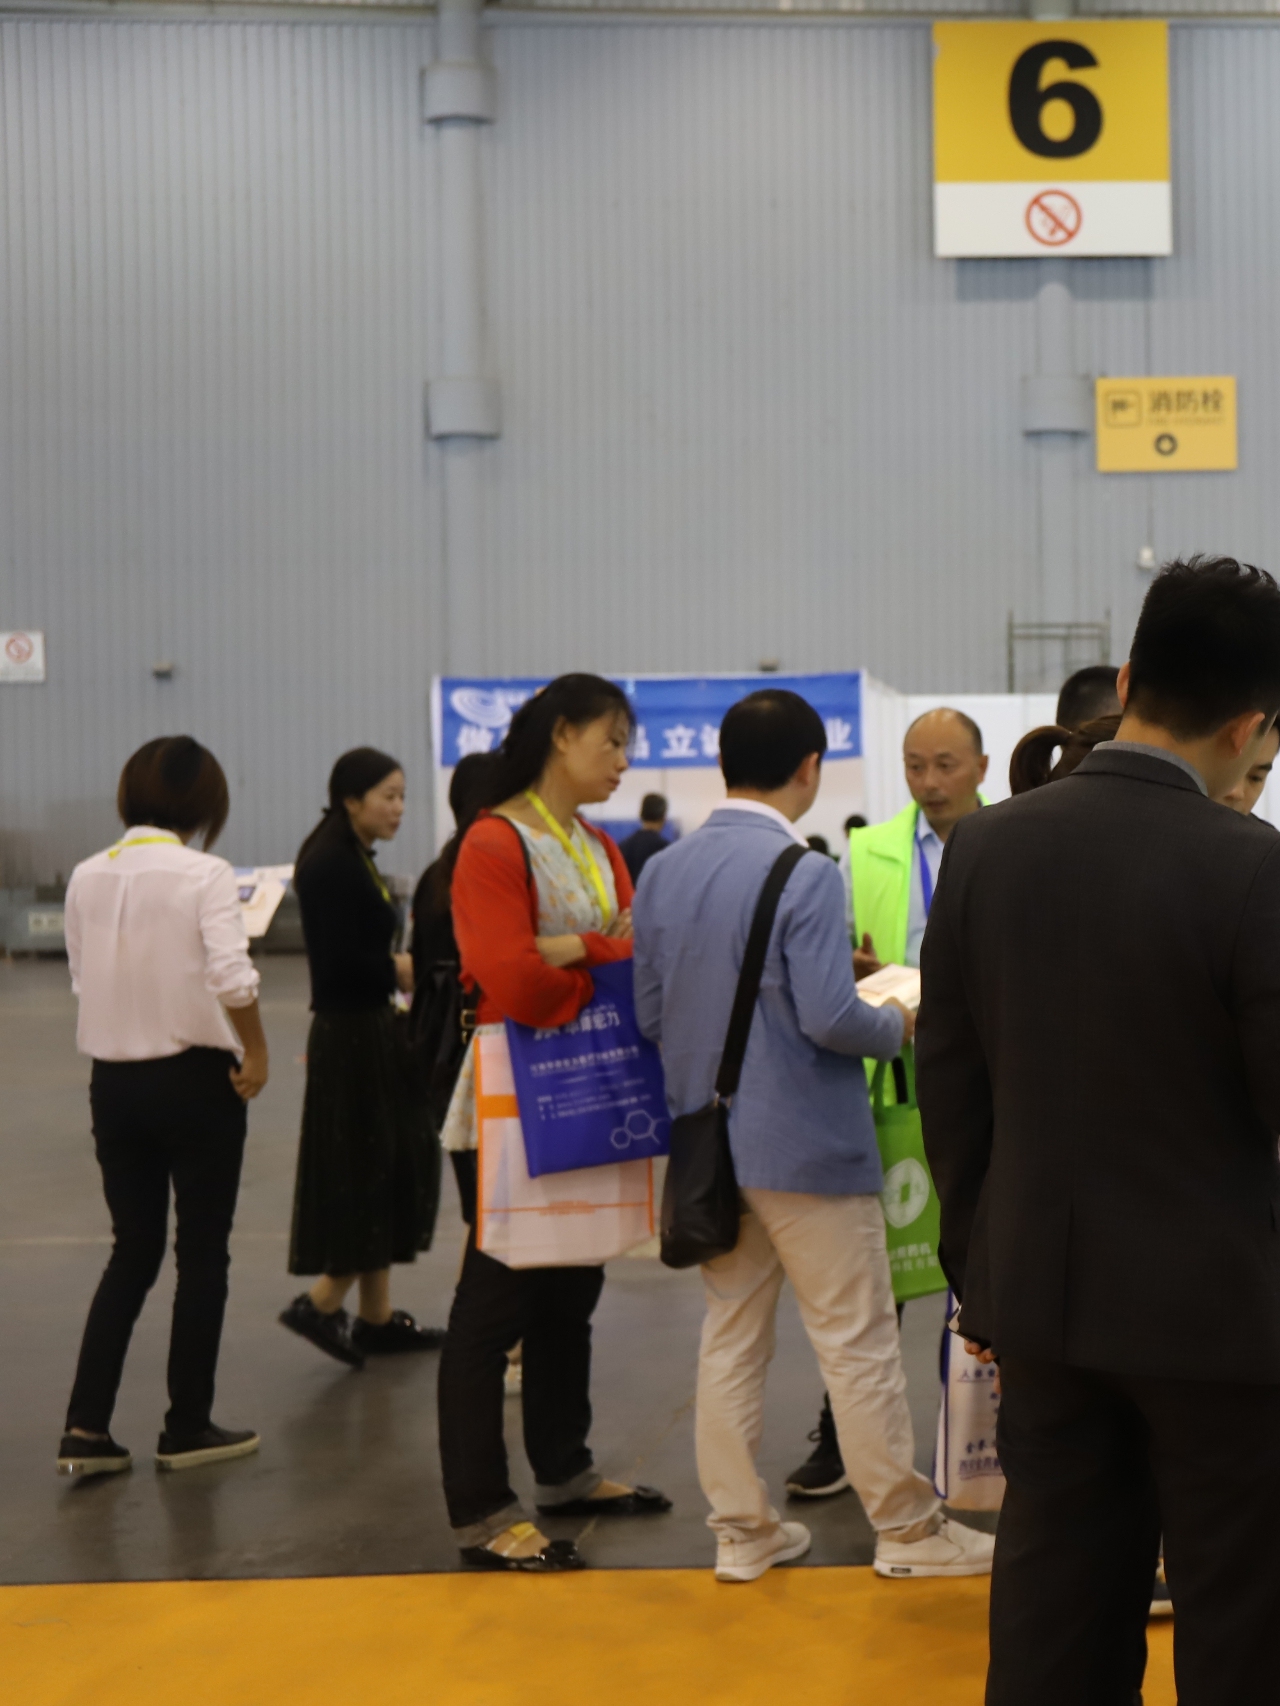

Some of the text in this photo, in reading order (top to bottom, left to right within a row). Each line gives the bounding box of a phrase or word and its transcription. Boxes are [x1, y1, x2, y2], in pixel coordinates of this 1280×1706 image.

[1007, 39, 1104, 159] 6
[1149, 388, 1224, 414] 消防栓
